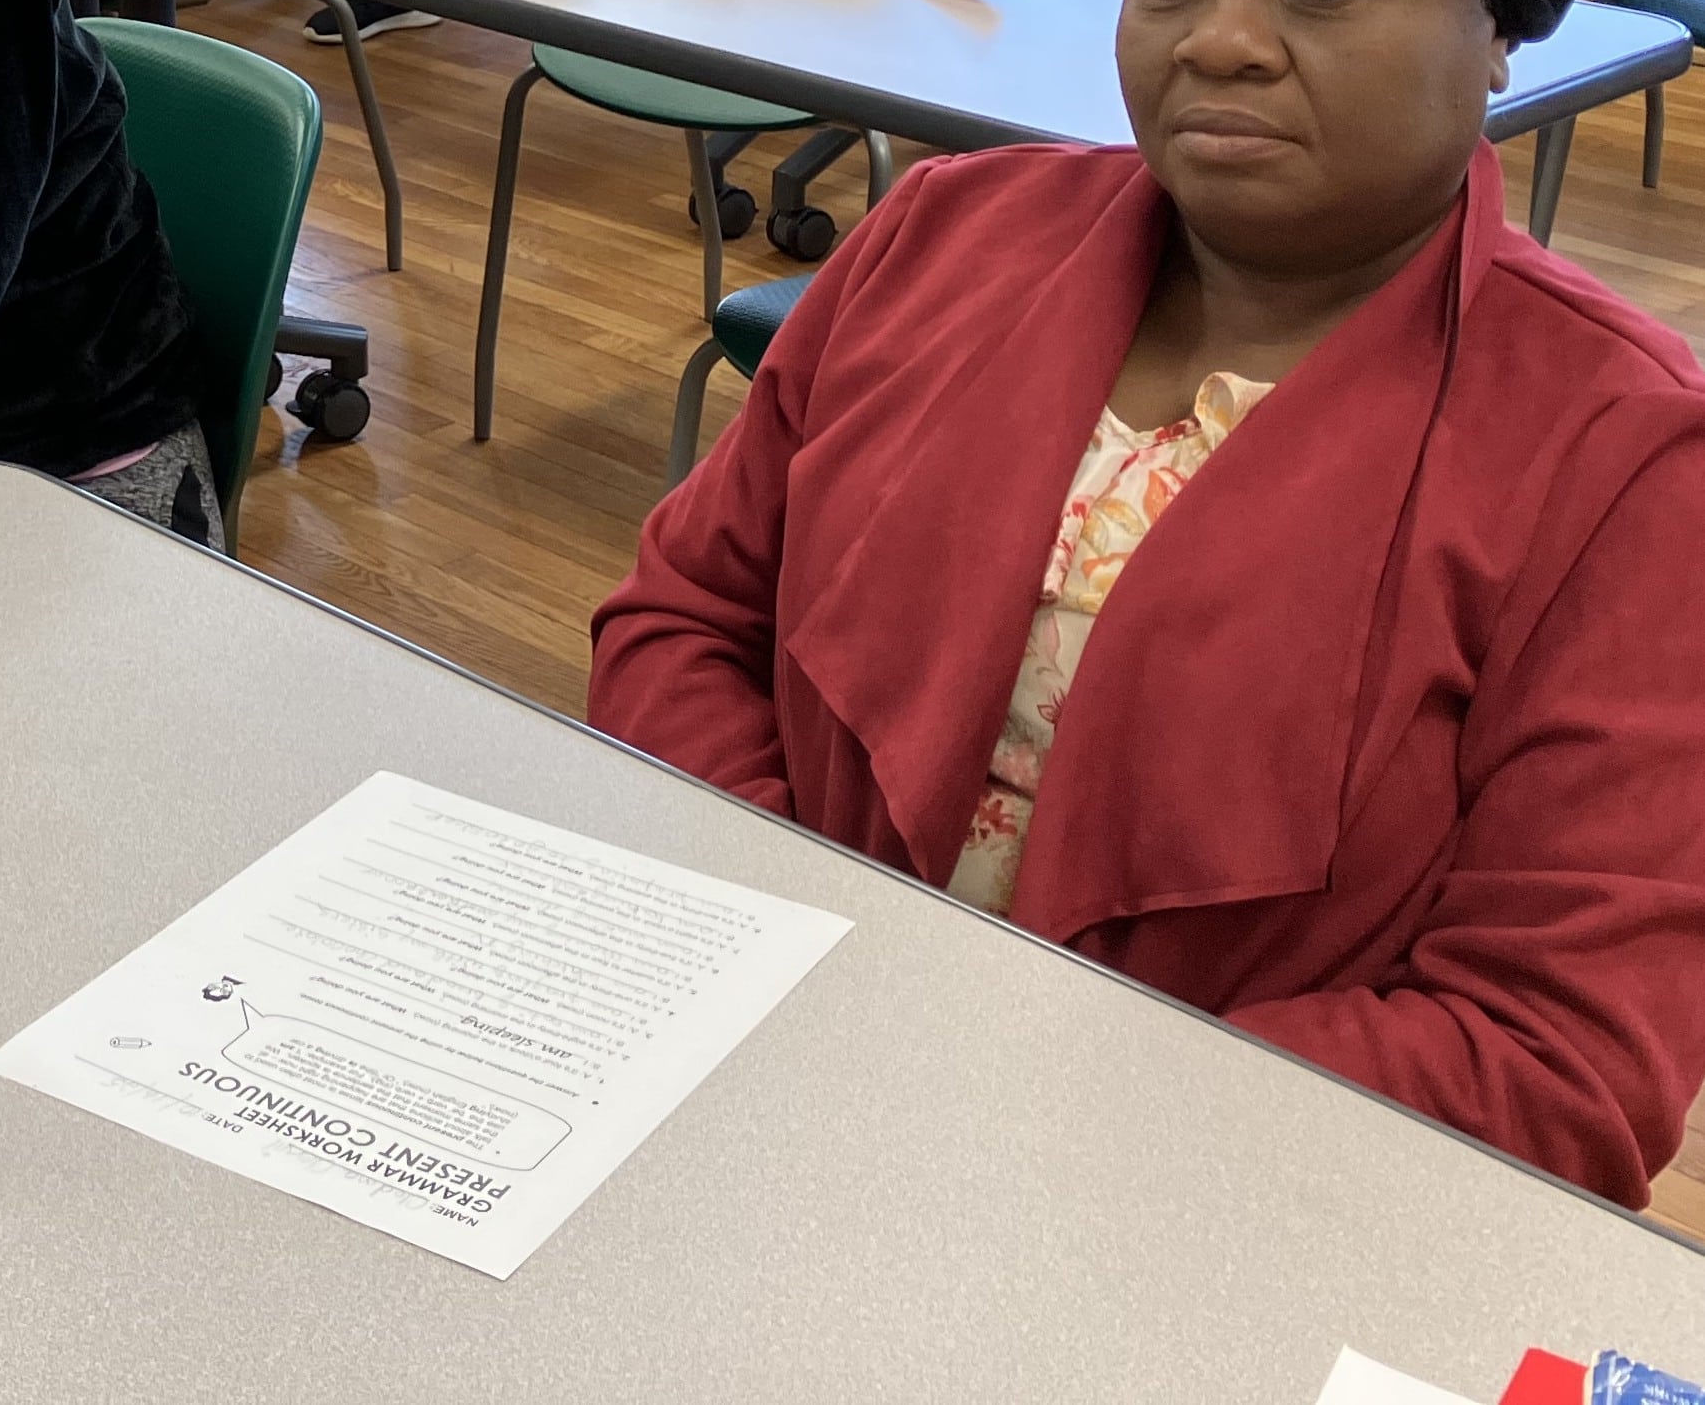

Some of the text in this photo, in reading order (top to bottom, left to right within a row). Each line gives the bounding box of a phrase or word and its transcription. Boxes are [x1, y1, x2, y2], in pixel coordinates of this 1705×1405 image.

[537, 1043, 573, 1060] am
[173, 1059, 513, 1201] PRESENT CONTINUOUS
[197, 1111, 245, 1134] DATE:
[230, 1104, 495, 1216] GRAMMAR WORKSHEET
[426, 1202, 480, 1228] NAME:
